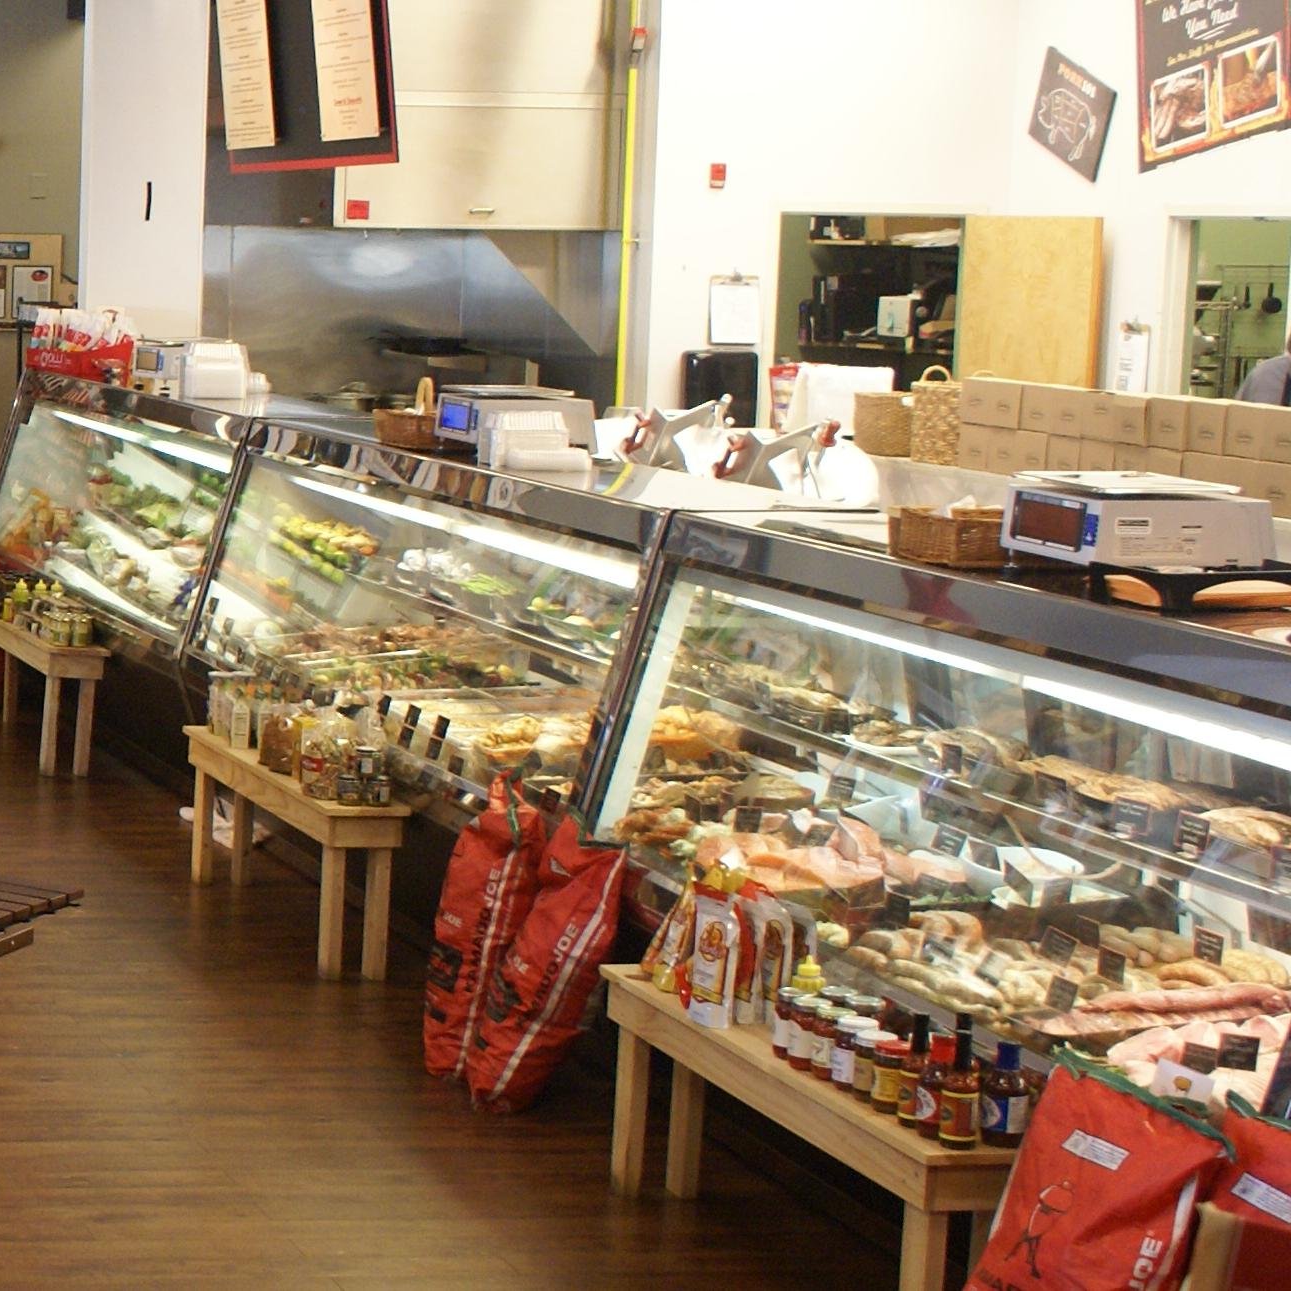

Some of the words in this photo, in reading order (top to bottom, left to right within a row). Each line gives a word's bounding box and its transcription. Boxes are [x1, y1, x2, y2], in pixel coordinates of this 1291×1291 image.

[1210, 1, 1239, 26] Need
[482, 867, 502, 909] JOE
[552, 922, 579, 964] JOE
[1129, 1235, 1164, 1291] JOE
